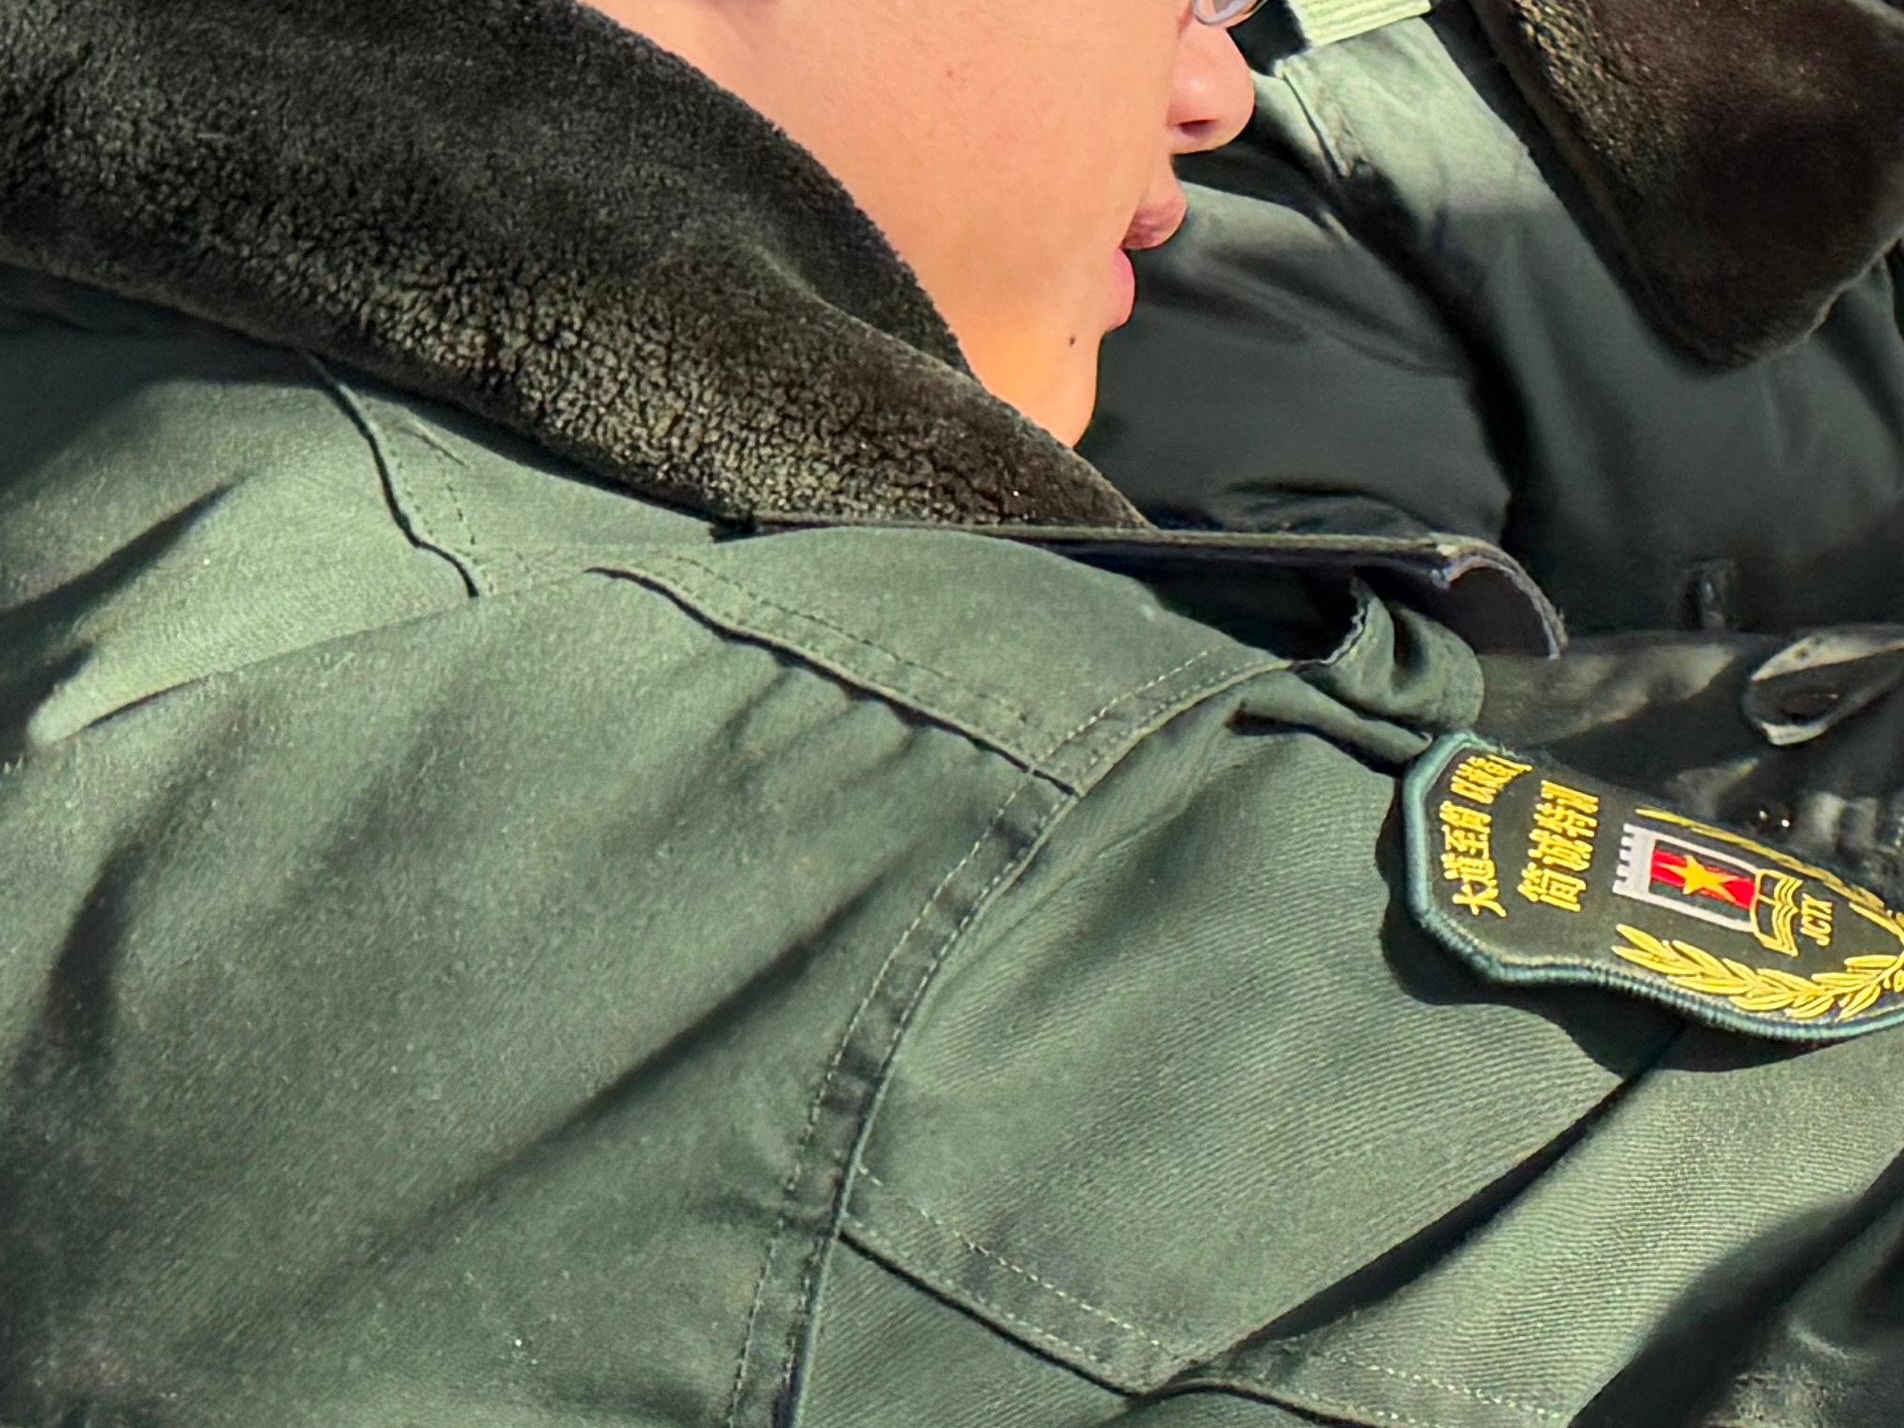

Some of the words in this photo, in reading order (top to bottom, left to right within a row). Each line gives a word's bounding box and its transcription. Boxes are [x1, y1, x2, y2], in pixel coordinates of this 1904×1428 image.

[1438, 800, 1507, 918] 大道至简
[1517, 779, 1599, 913] 简诚特训
[1799, 892, 1833, 947] JCTX
